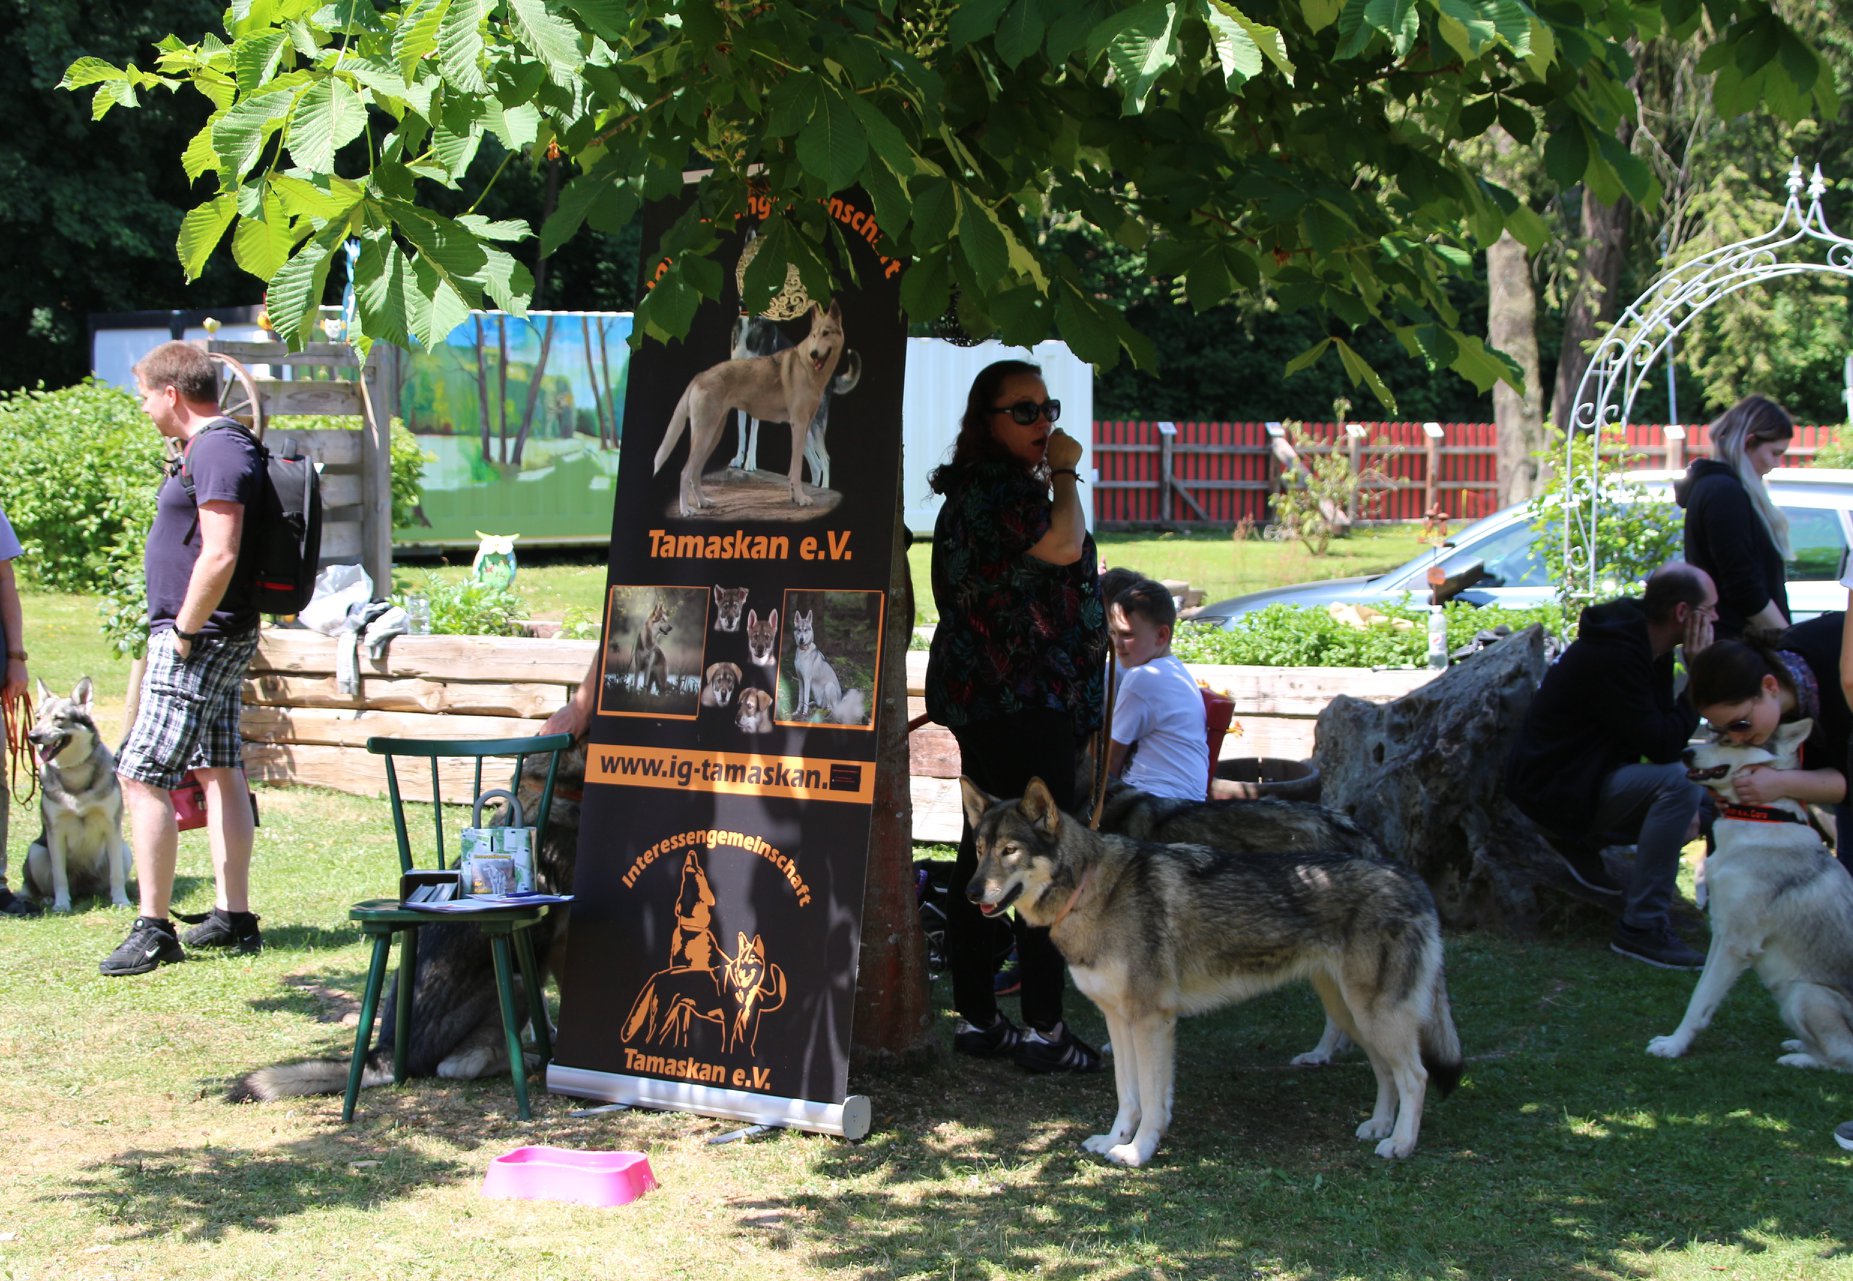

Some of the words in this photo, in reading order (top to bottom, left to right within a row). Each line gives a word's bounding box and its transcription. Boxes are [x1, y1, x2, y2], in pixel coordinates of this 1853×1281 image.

[649, 530, 789, 559] Tamaskan
[799, 531, 852, 561] e.V.
[600, 755, 828, 790] www.ig-tamaskan.
[621, 829, 812, 908] Interessengemeinschaft
[624, 1047, 726, 1084] Tamaskan
[732, 1066, 771, 1090] e.V.
